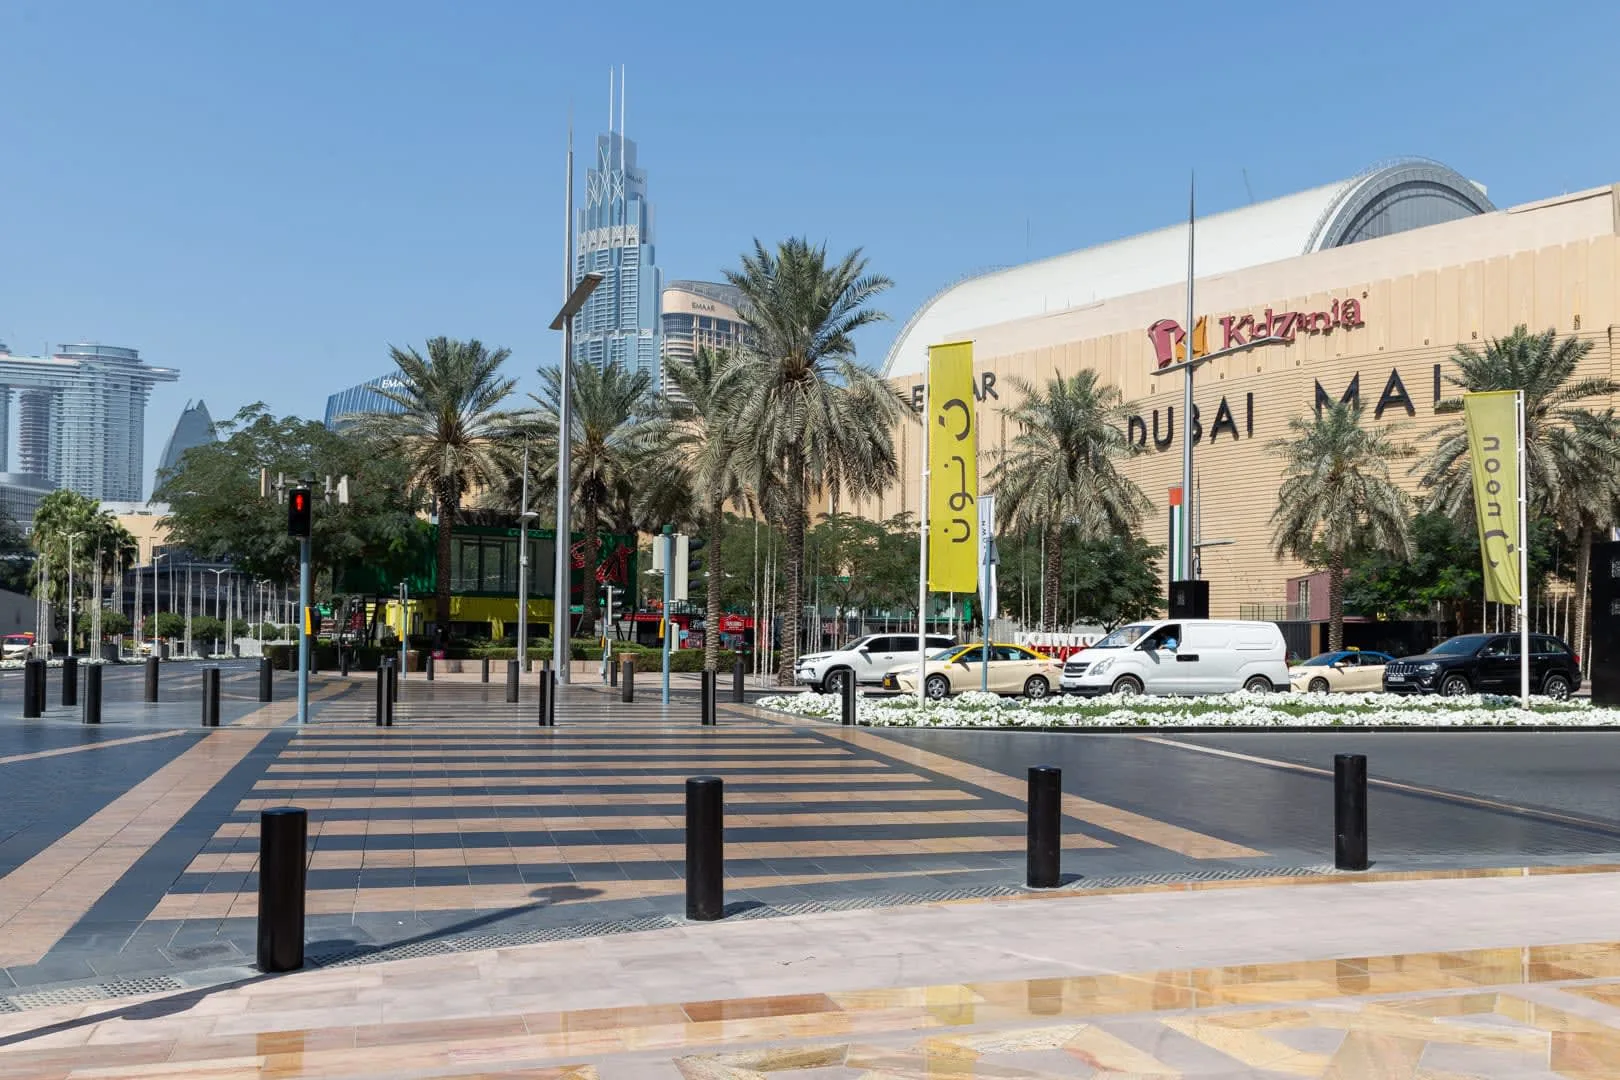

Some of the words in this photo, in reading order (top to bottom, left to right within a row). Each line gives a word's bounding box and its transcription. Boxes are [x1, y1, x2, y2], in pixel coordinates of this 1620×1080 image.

[1219, 297, 1363, 350] KidZania
[382, 375, 417, 389] EMA
[912, 371, 999, 412] EAR
[1127, 391, 1254, 451] DUBAI
[1313, 363, 1464, 422] MAL
[1482, 436, 1501, 517] noon
